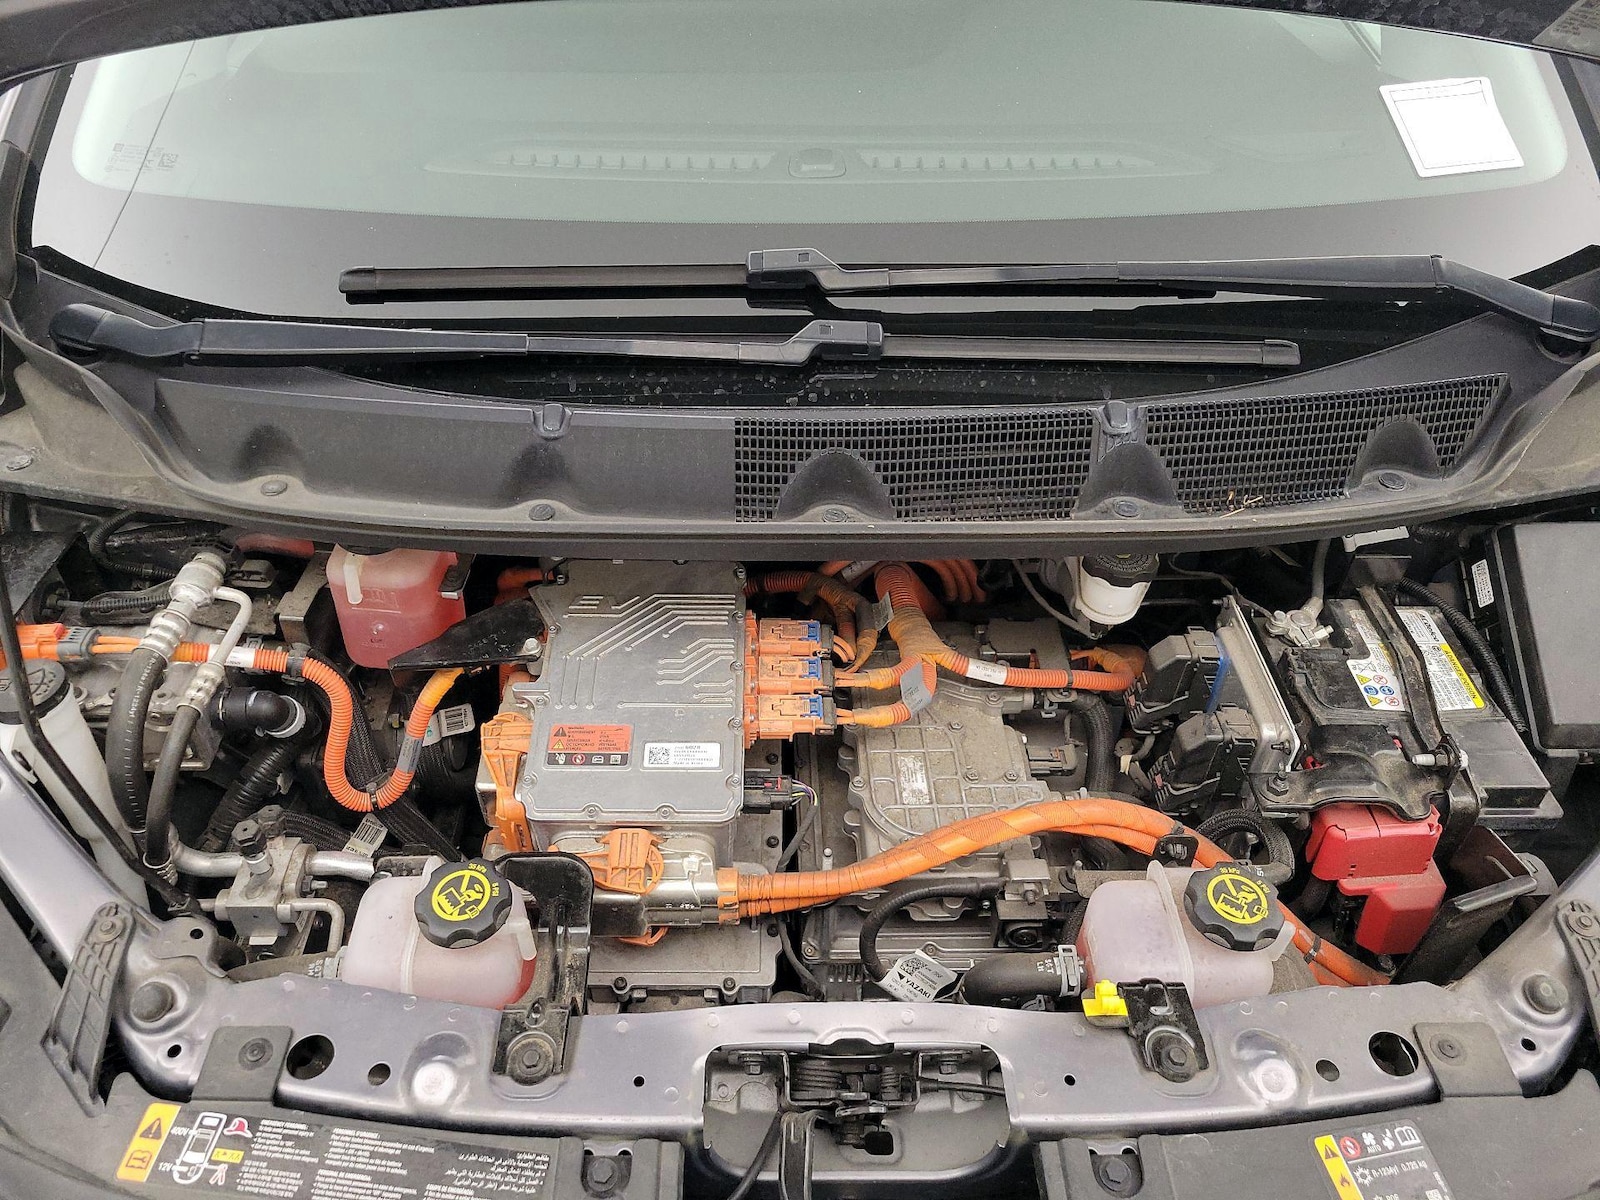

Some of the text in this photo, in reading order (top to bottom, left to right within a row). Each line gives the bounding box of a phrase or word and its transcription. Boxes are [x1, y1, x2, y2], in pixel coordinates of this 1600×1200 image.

[905, 978, 931, 999] YAZAKI
[170, 1126, 188, 1136] 400V
[1367, 1145, 1382, 1153] AUTO
[1418, 1160, 1428, 1169] kg
